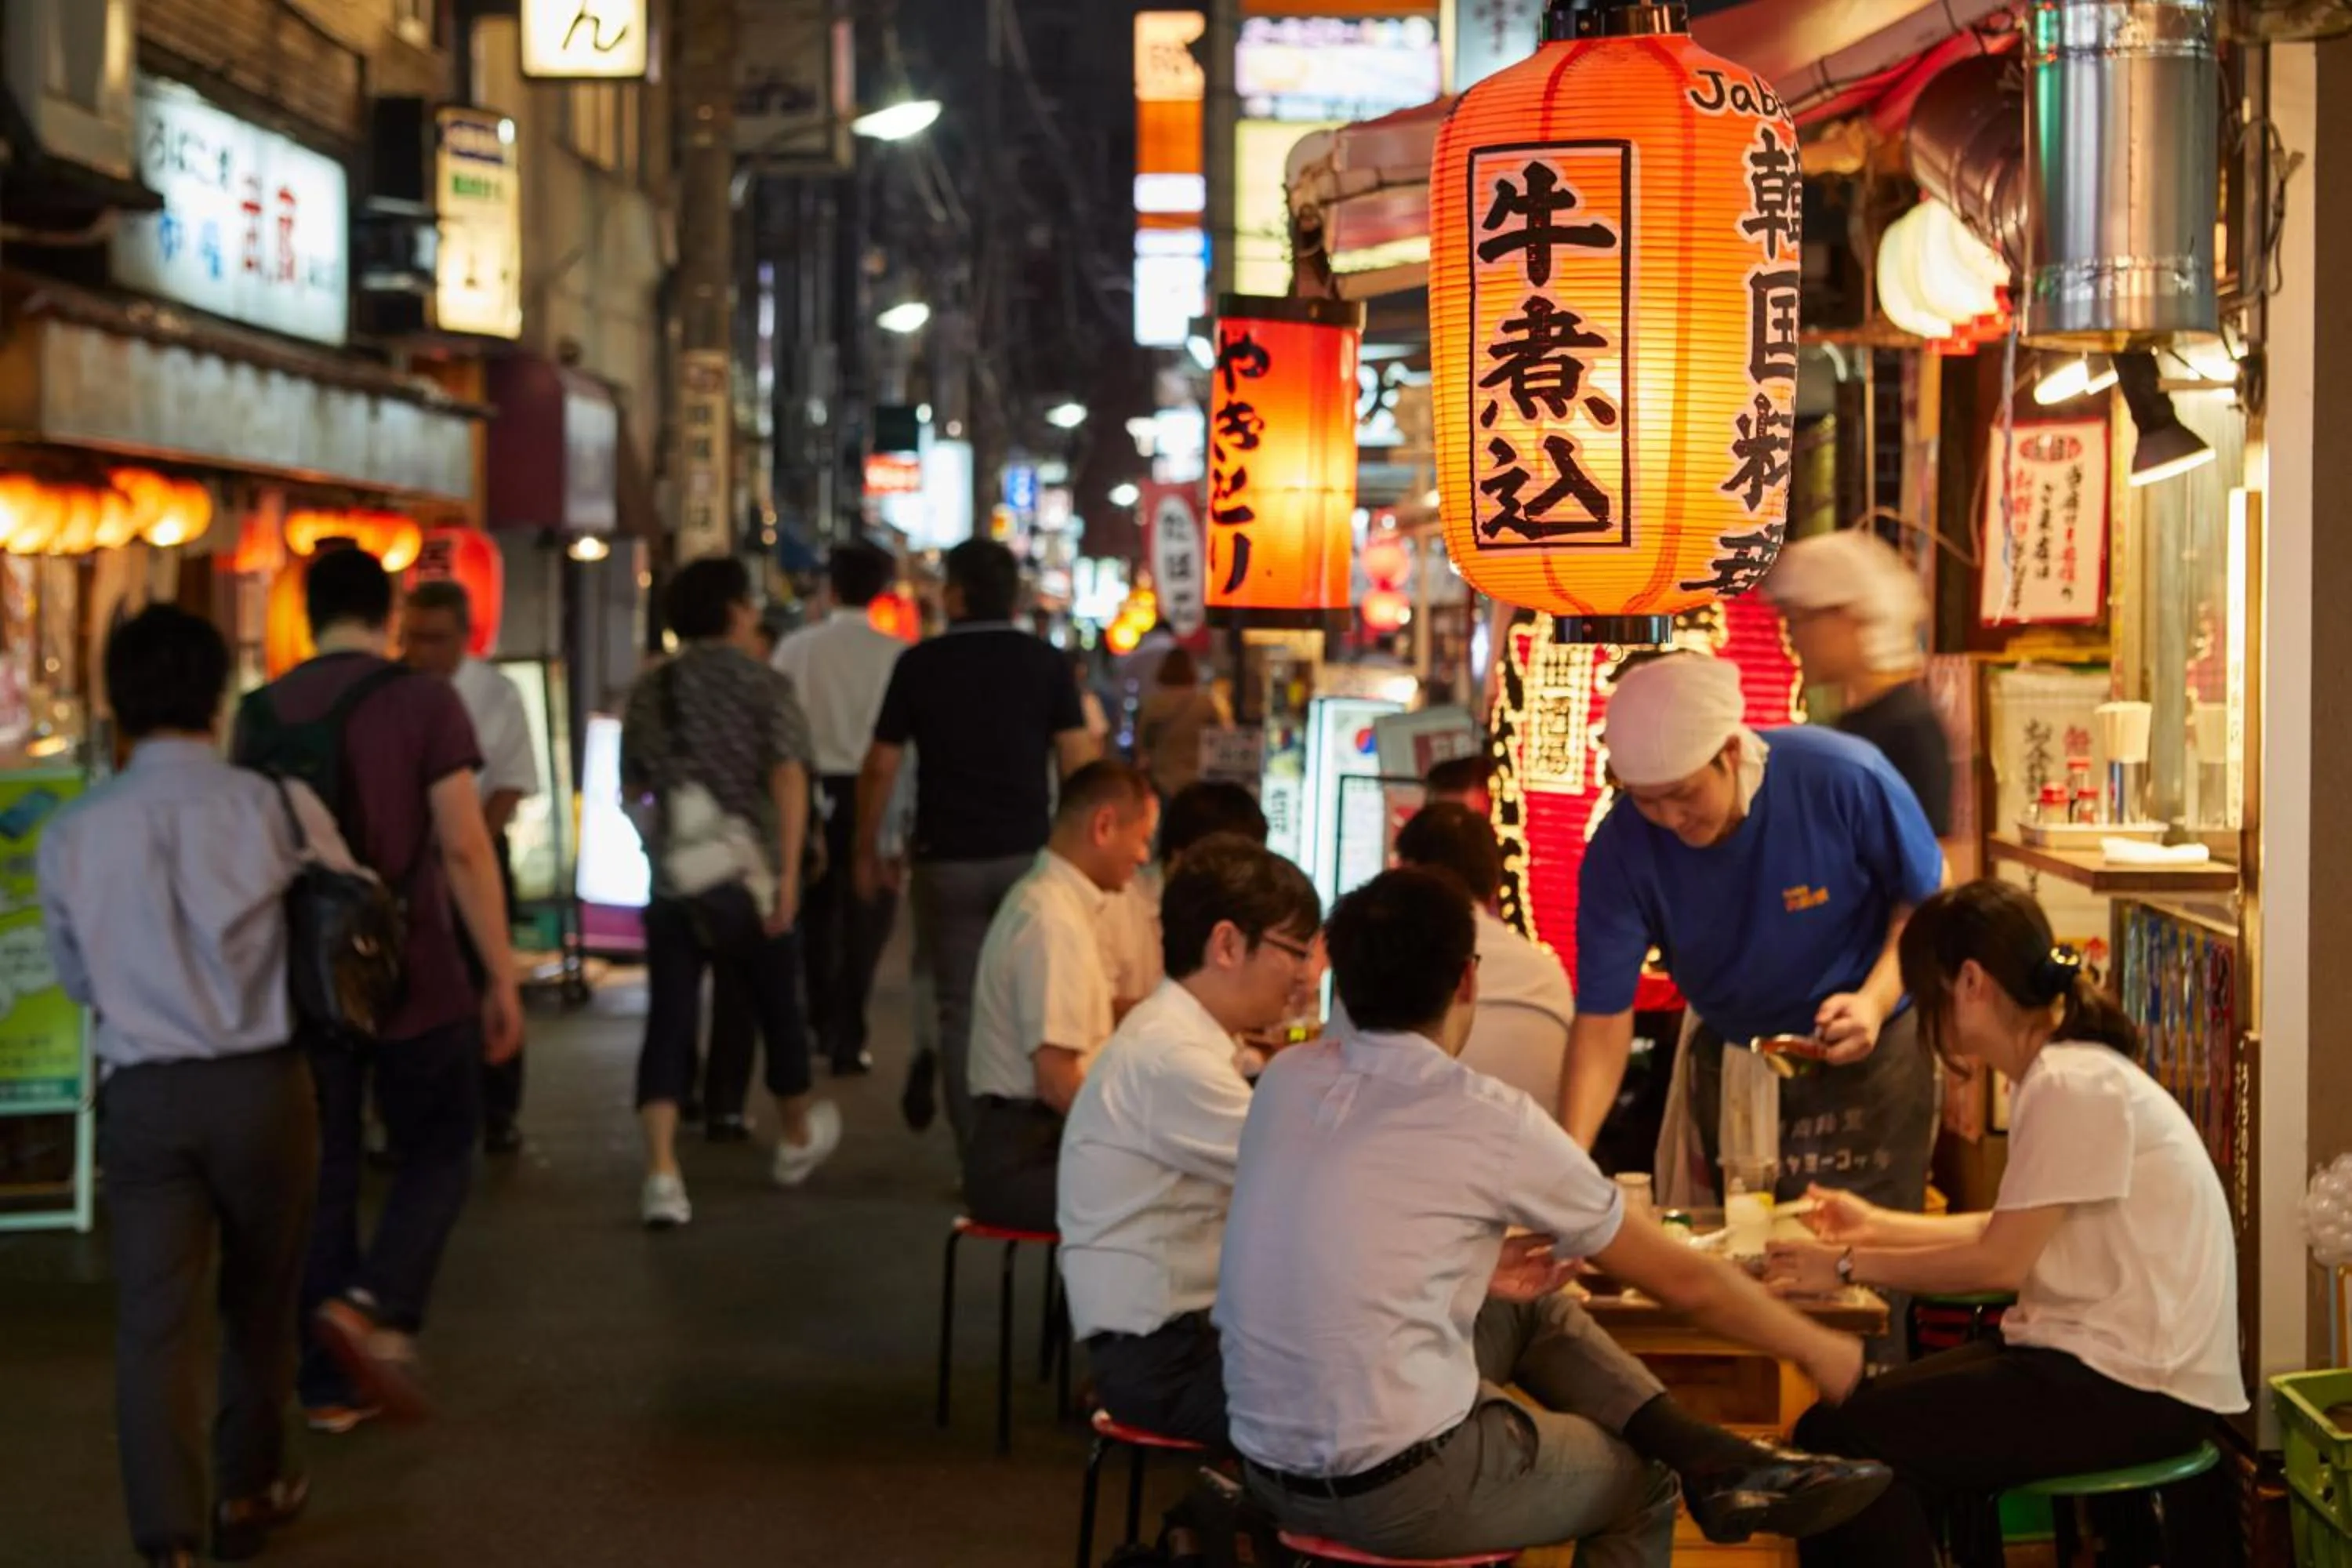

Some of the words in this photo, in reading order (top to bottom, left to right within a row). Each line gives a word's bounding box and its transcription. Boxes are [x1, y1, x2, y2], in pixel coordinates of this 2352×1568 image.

[1690, 69, 1792, 125] Jab
[1210, 328, 1271, 596] やきとり
[1477, 161, 1617, 541] 牛煮込
